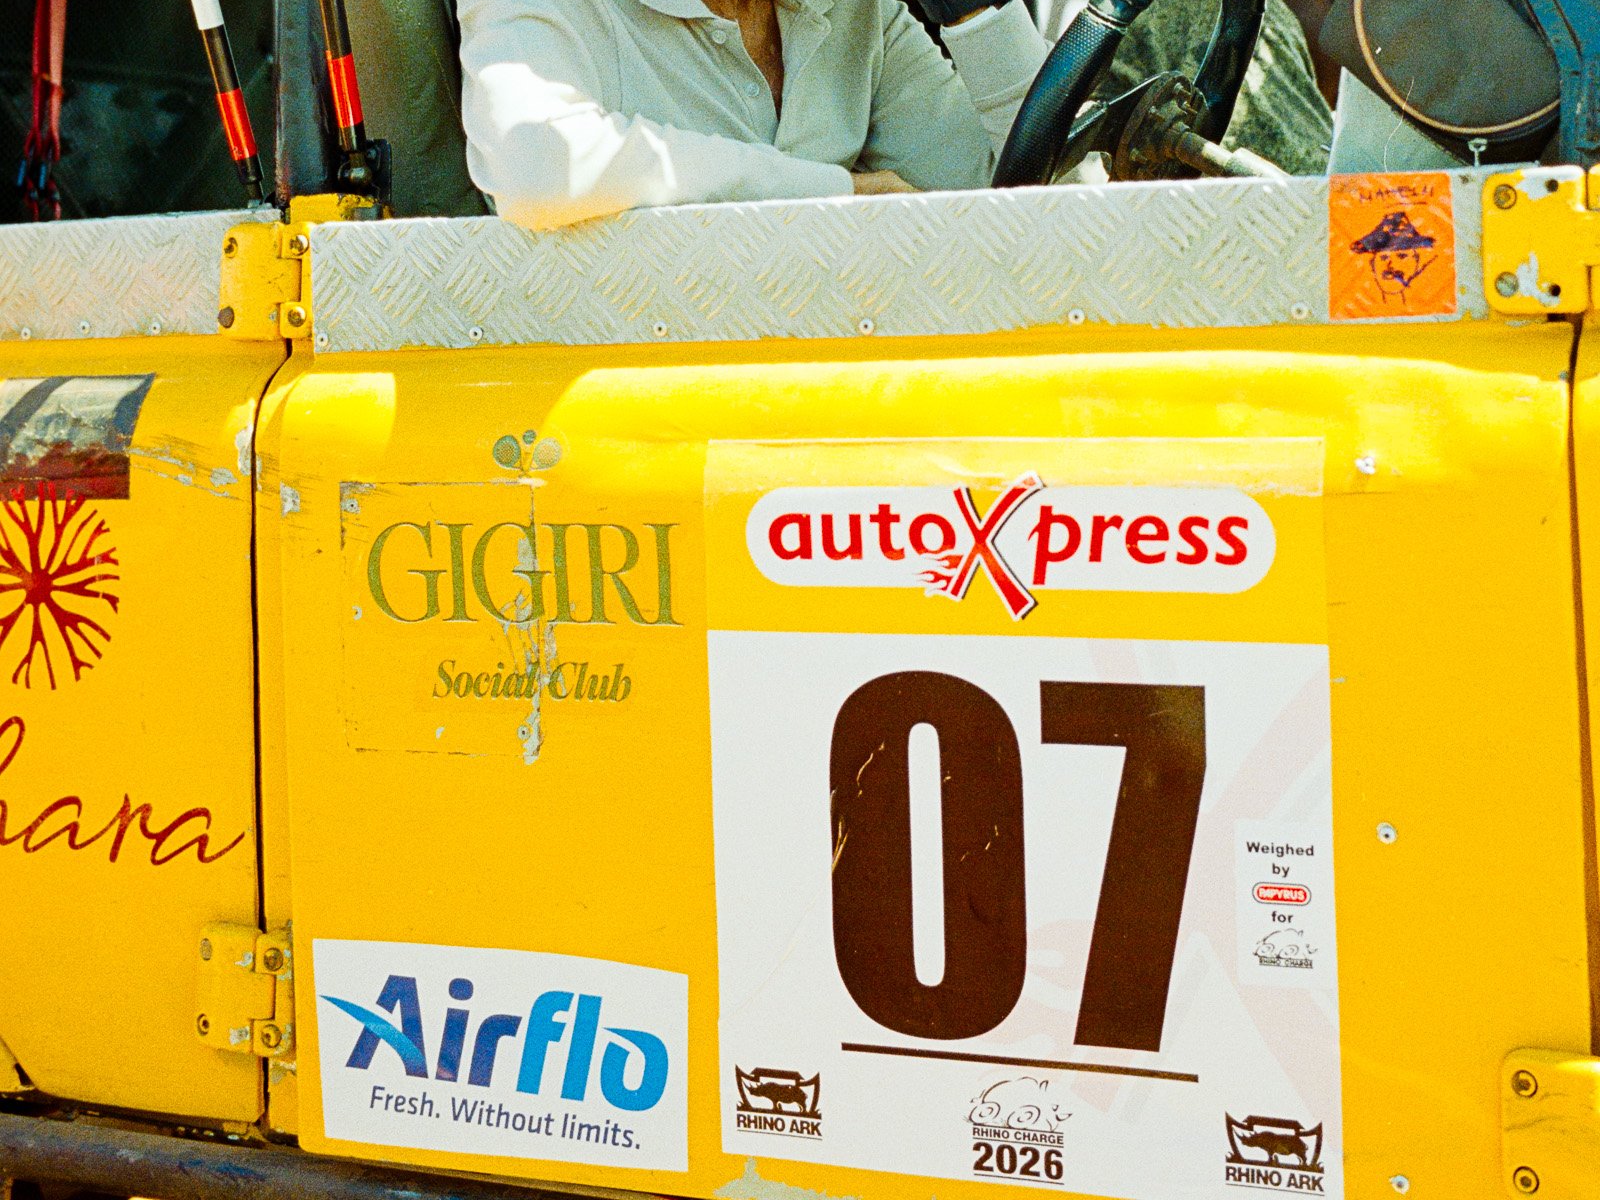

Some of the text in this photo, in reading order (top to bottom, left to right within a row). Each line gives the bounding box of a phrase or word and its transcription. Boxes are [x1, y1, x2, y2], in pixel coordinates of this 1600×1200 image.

[767, 473, 1250, 619] autoXpress
[367, 521, 684, 626] GIGIRI
[432, 659, 632, 702] Social Club
[829, 670, 1207, 1052] 07
[1246, 841, 1315, 857] Weighed
[1272, 863, 1290, 877] by
[1271, 911, 1294, 923] for
[319, 974, 669, 1112] Airflo
[369, 1085, 641, 1150] Fresh. Without limits.
[736, 1113, 822, 1136] RHINO ARK
[972, 1127, 1064, 1145] RHINO CHARGE
[972, 1141, 1064, 1180] 2026
[1225, 1166, 1324, 1192] RHINO ARK
